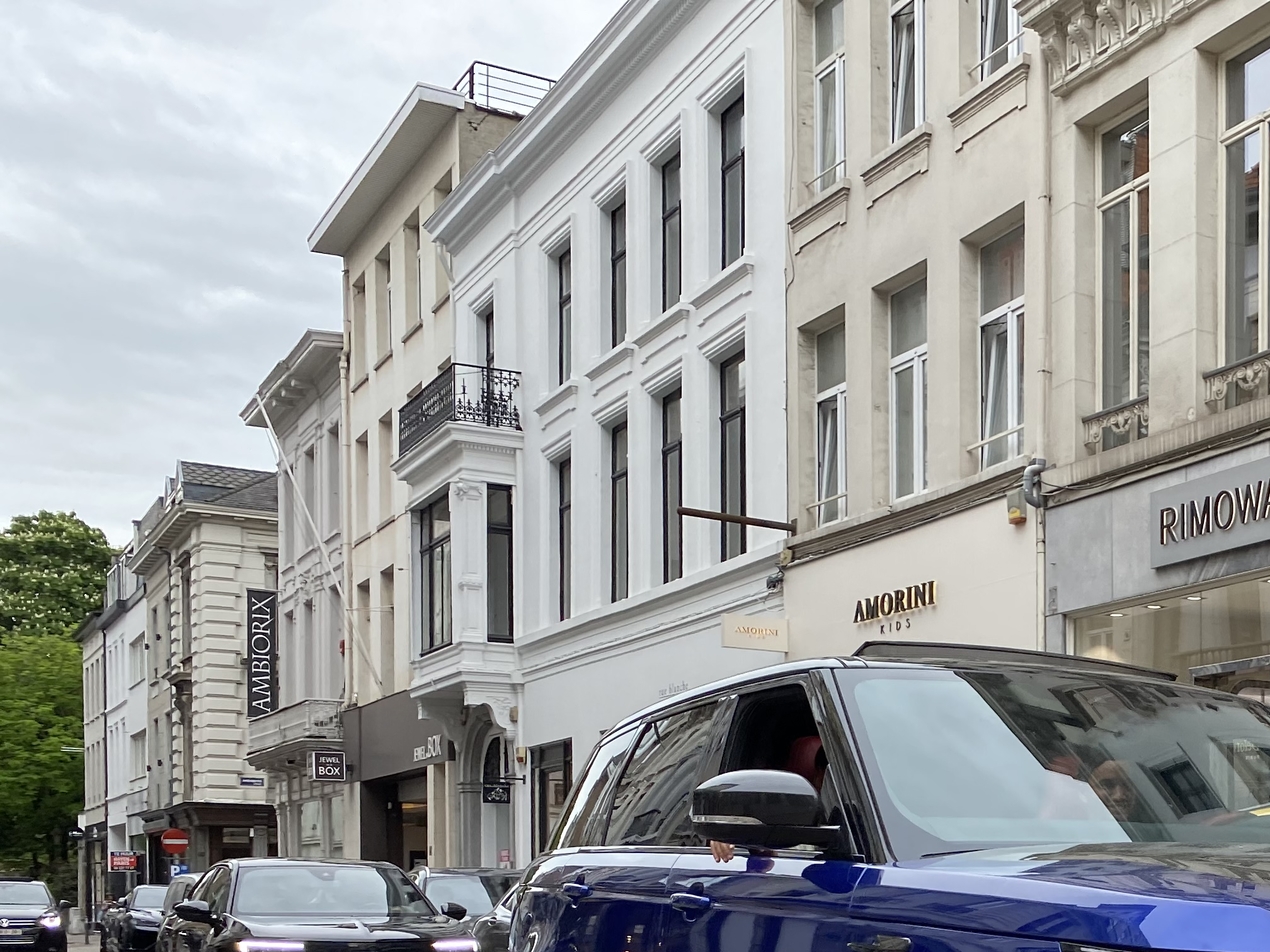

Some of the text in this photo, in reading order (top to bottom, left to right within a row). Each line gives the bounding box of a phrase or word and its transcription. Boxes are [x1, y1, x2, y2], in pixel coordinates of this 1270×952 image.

[853, 580, 936, 624] AMORINI
[735, 626, 778, 636] AMORINI
[880, 618, 911, 635] KIDS
[252, 595, 275, 712] AMBIORIX
[668, 681, 689, 695] blanche
[318, 766, 340, 776] BOX
[170, 866, 180, 876] P
